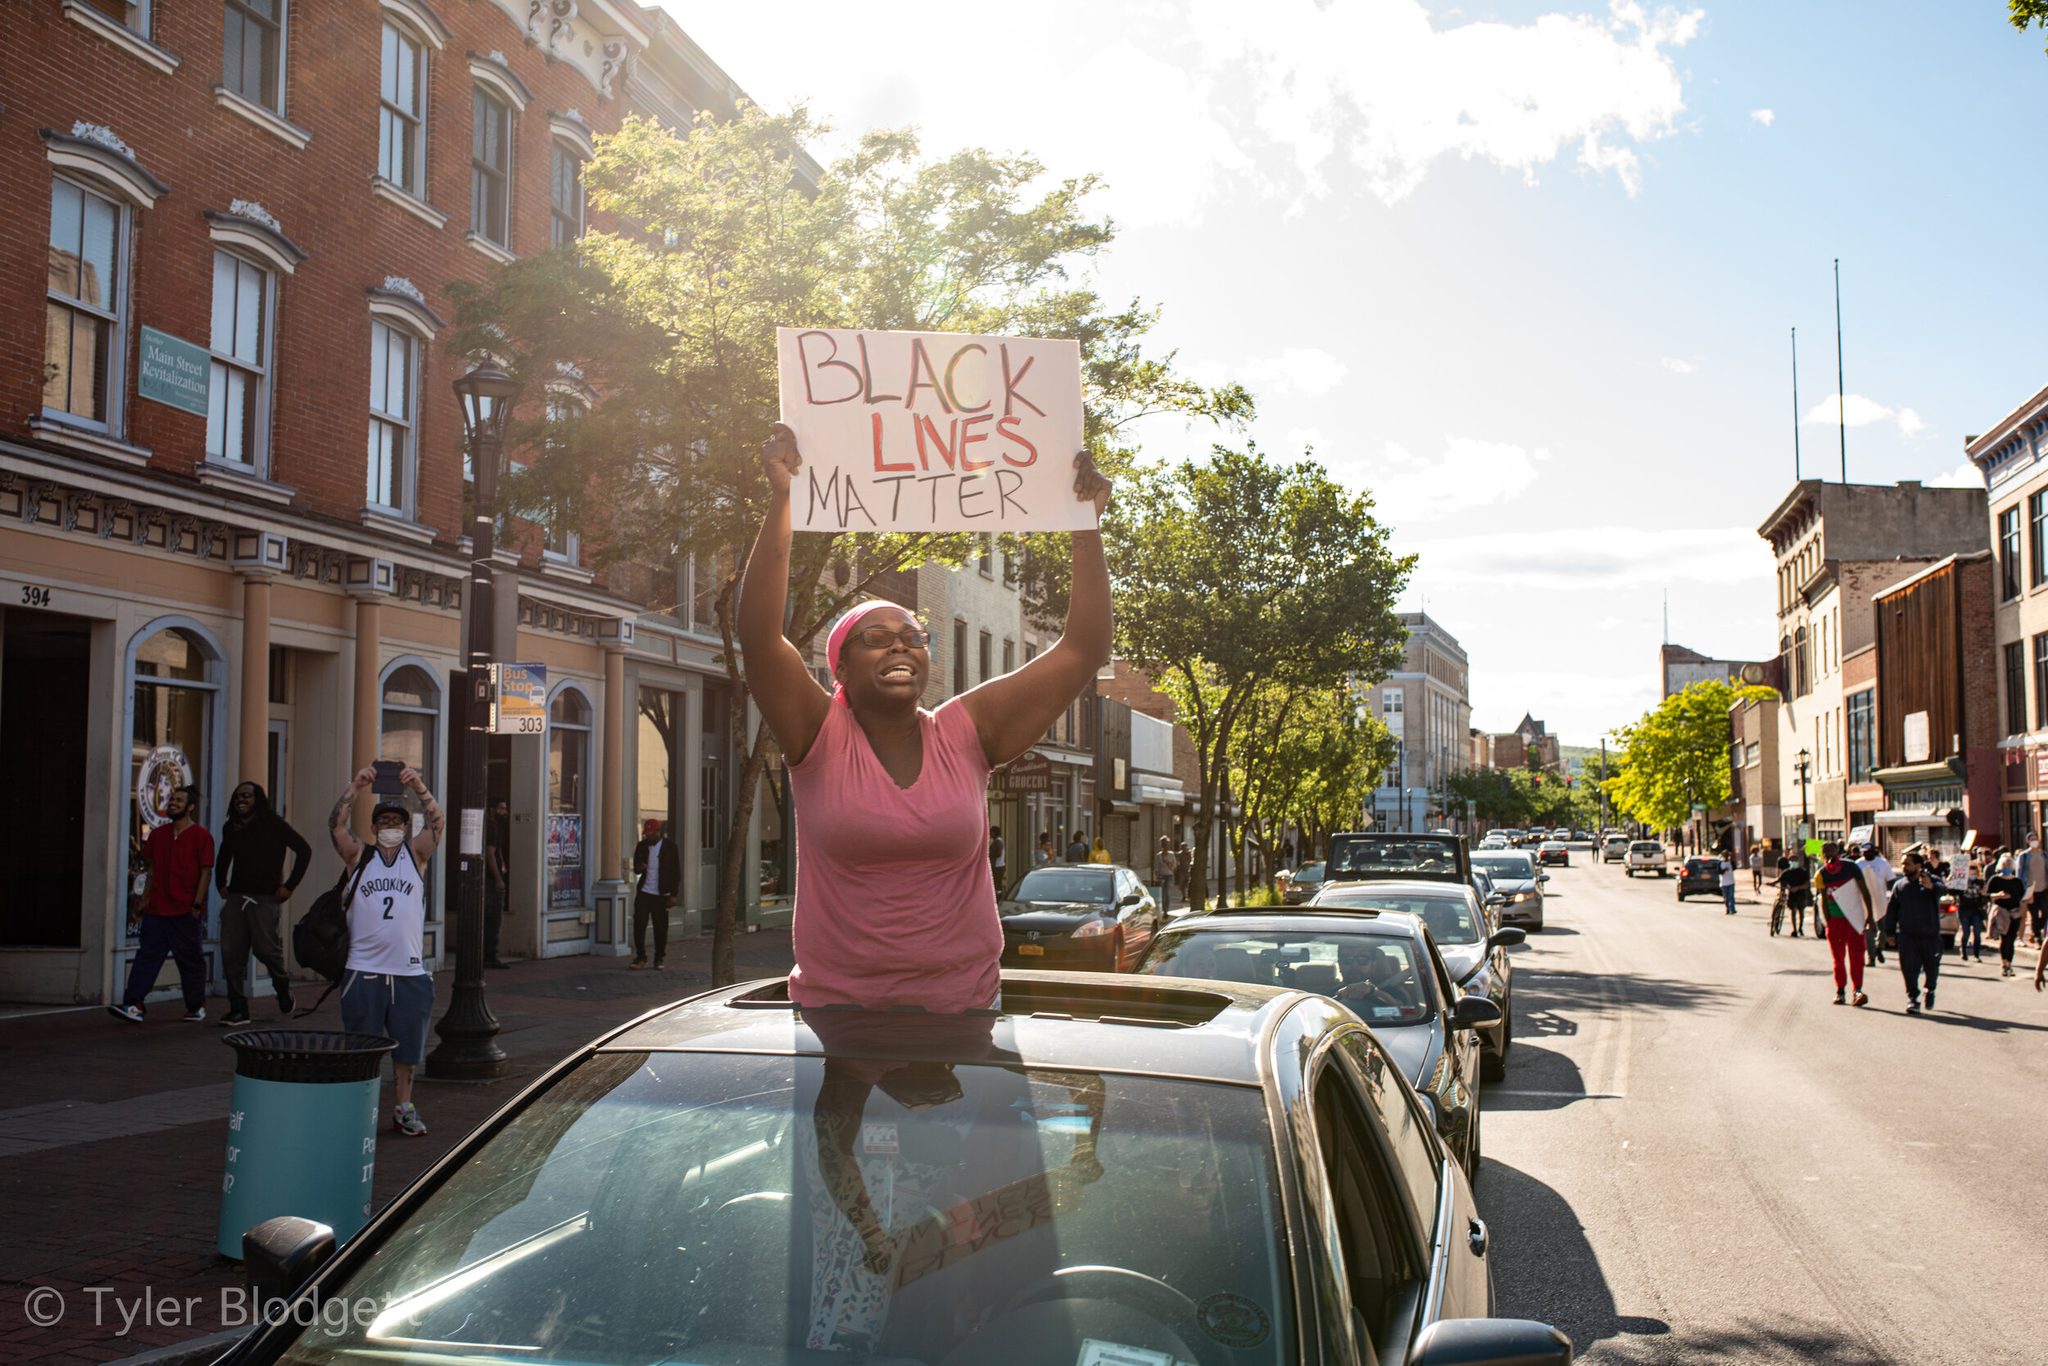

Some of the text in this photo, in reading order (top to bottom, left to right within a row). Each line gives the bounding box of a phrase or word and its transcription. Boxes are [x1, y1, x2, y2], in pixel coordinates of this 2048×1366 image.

[148, 345, 203, 376] Main Street
[142, 360, 206, 395] Revitalization
[798, 330, 1046, 417] BLACK
[872, 412, 1038, 472] LIVES
[806, 465, 1028, 528] MATTER
[22, 585, 51, 607] 394
[503, 667, 528, 680] Bus
[503, 679, 534, 695] Stop
[519, 717, 543, 733] 303
[360, 878, 414, 898] BROOKLYN
[383, 896, 394, 920] 2
